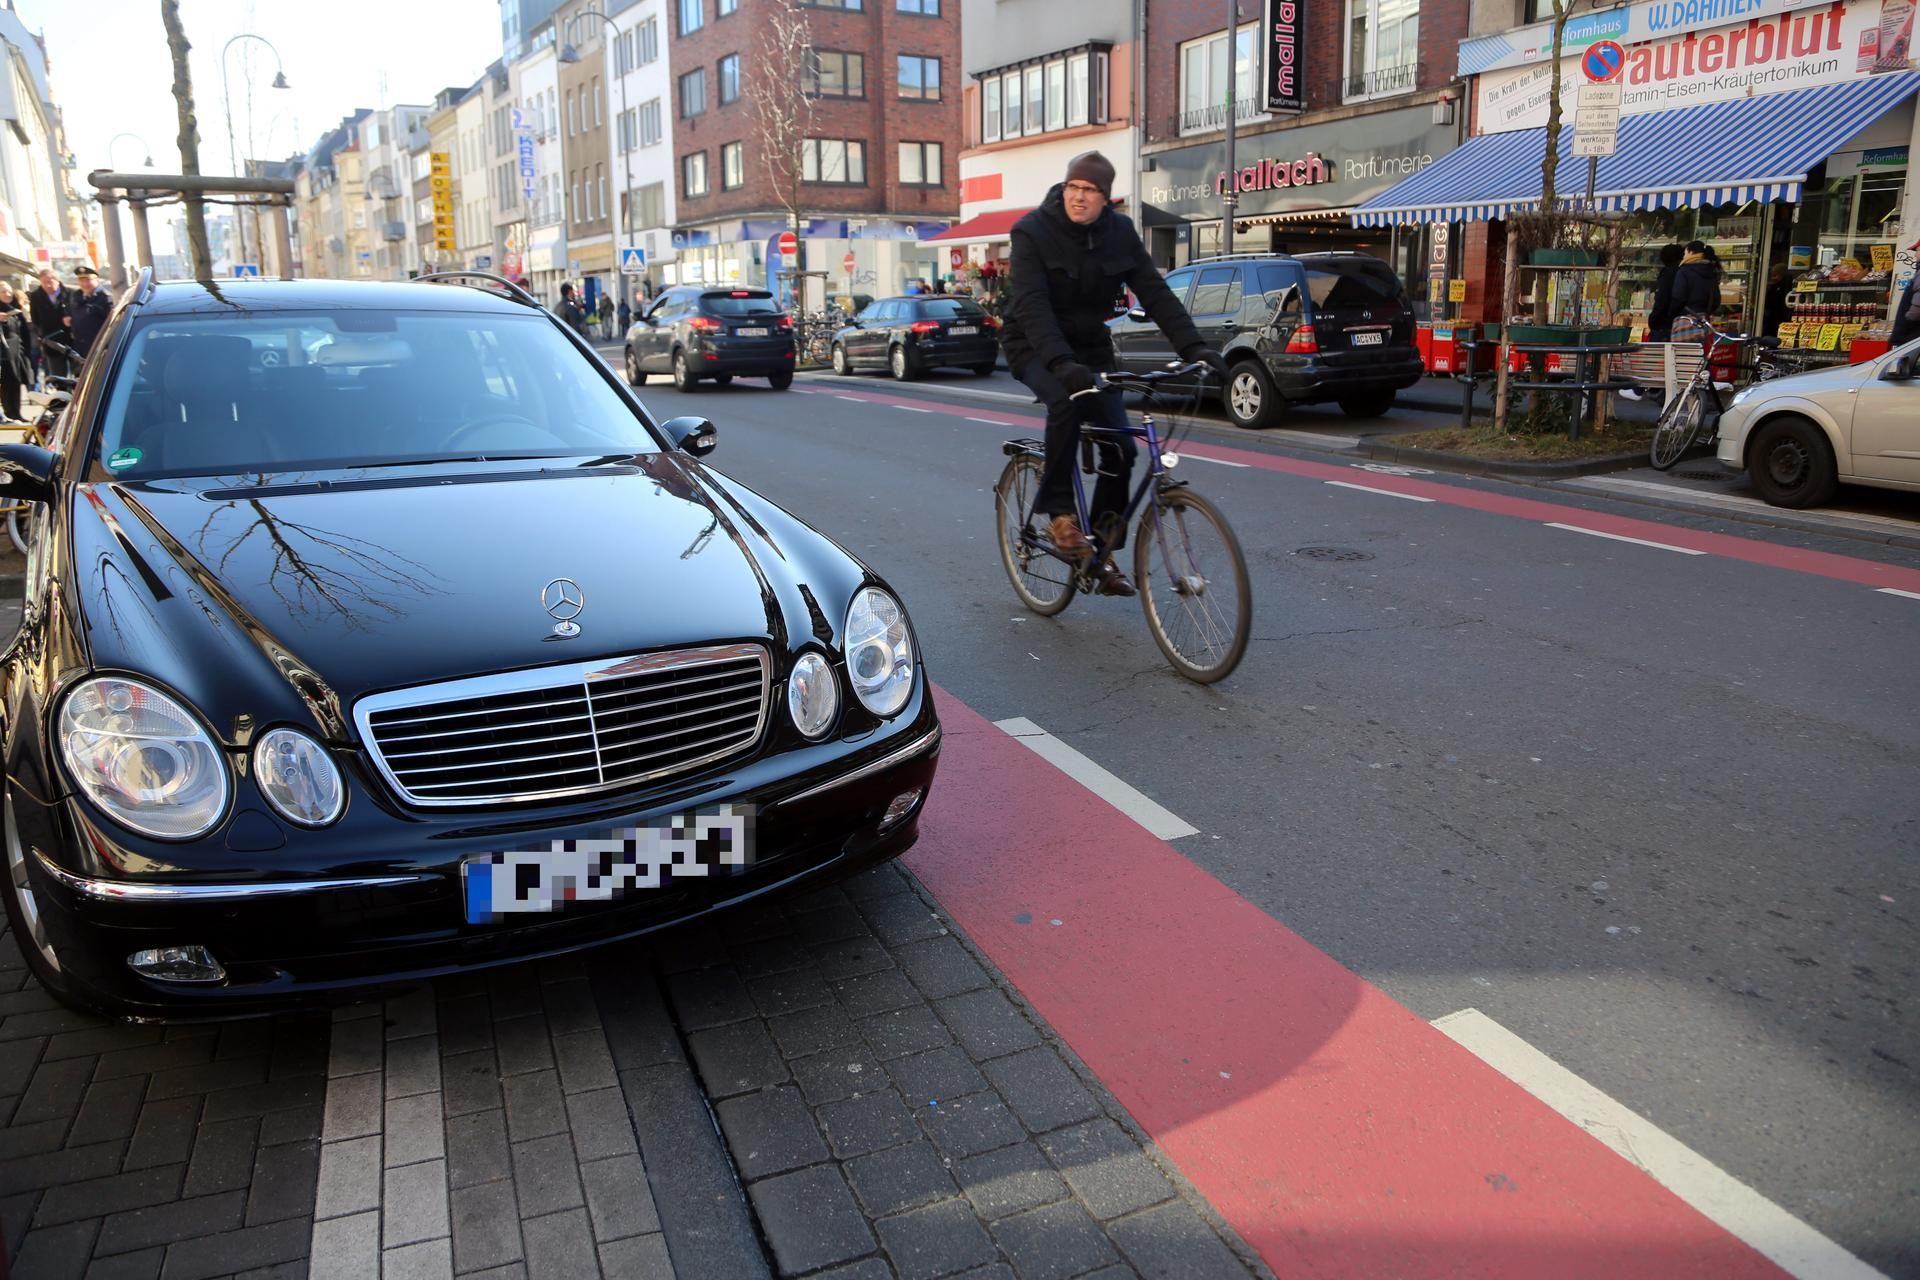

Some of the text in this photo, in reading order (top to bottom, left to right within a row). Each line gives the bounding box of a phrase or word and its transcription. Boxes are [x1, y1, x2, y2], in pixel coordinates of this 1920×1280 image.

[1276, 0, 1295, 96] malla
[1587, 2, 1846, 85] räuterblut
[1488, 91, 1499, 102] Die
[1501, 81, 1517, 95] Kraft
[1519, 74, 1530, 88] der
[1622, 58, 1838, 105] tamin-Eisen-Kräutertonikum
[1506, 103, 1525, 119] gegen
[1580, 136, 1610, 144] werktags
[1863, 152, 1908, 164] Reformhau
[520, 135, 535, 199] KREDIT
[1152, 183, 1210, 203] Parfümerie
[1344, 151, 1433, 181] Parfümerie
[432, 154, 449, 249] APOTHEKE
